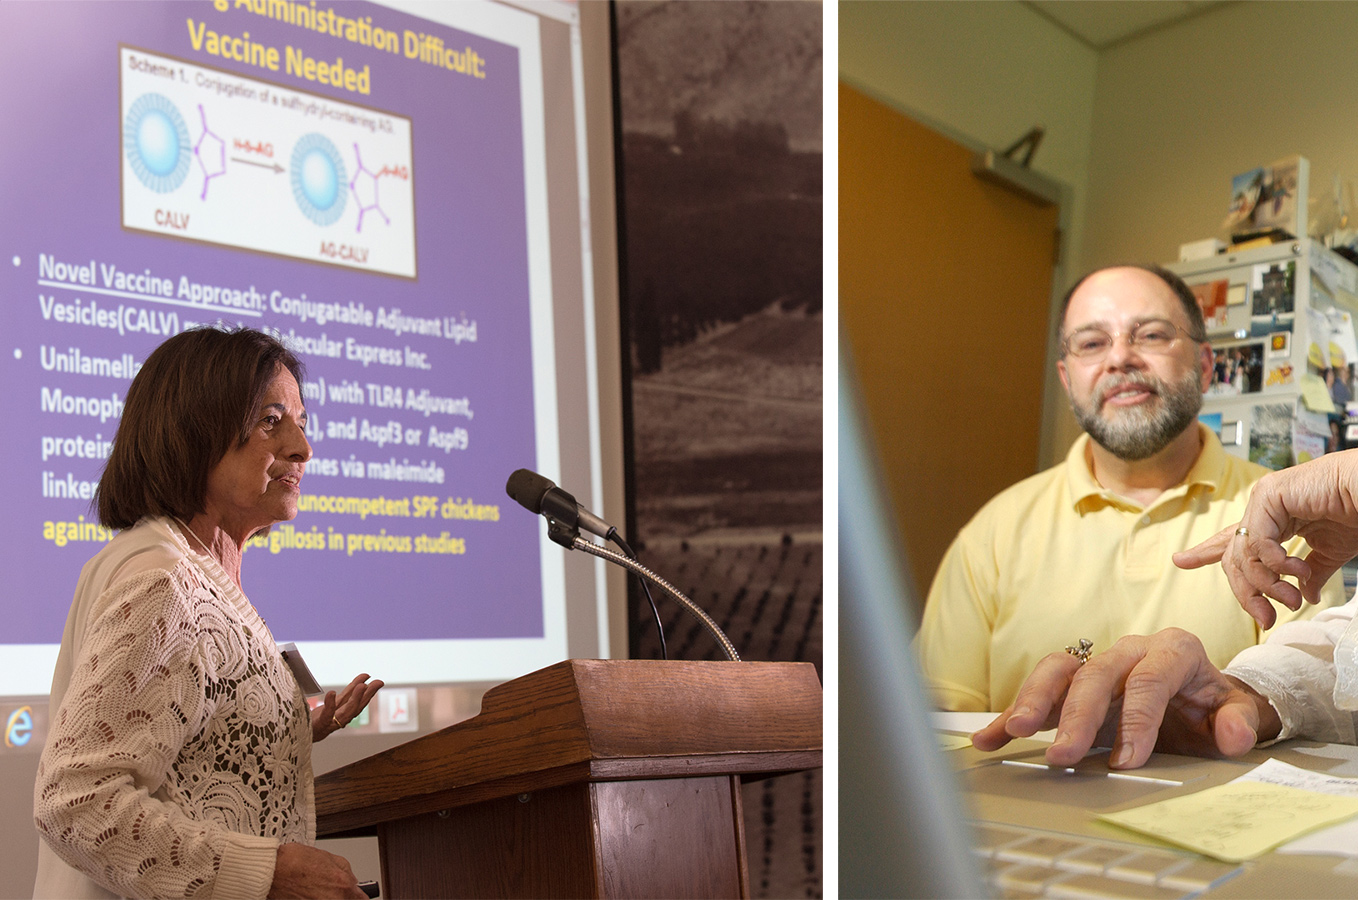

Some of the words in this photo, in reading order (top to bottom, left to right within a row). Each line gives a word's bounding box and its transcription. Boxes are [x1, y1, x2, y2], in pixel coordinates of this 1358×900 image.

[129, 55, 175, 80] Scheme
[187, 18, 279, 71] Vaccine
[286, 45, 370, 95] Needed
[403, 30, 486, 79] Difficult:
[154, 209, 190, 229] CALV
[319, 242, 369, 263] AG-CALV
[39, 253, 96, 285] Novel
[100, 262, 174, 297] Vaccine
[177, 275, 267, 311] Approach:
[270, 290, 374, 327] Conjugatable
[376, 307, 442, 337] Adjuvant
[444, 318, 477, 345] Lipid
[38, 294, 180, 336] Vesicles(CALV)
[346, 338, 402, 367] Express
[405, 346, 432, 370] Inc.
[329, 380, 364, 405] with
[405, 388, 474, 419] Adjuvant,
[41, 386, 126, 424] Monoph
[327, 417, 357, 441] and
[359, 420, 402, 448] Aspf3
[404, 428, 423, 446] or
[428, 425, 468, 453] Aspf9
[341, 454, 364, 479] via
[367, 458, 445, 484] maleimide
[298, 494, 410, 520] unocompetent
[413, 495, 438, 518] SPF
[441, 497, 500, 521] chickens
[328, 526, 344, 550] in
[348, 529, 412, 556] previous
[414, 532, 466, 554] studies
